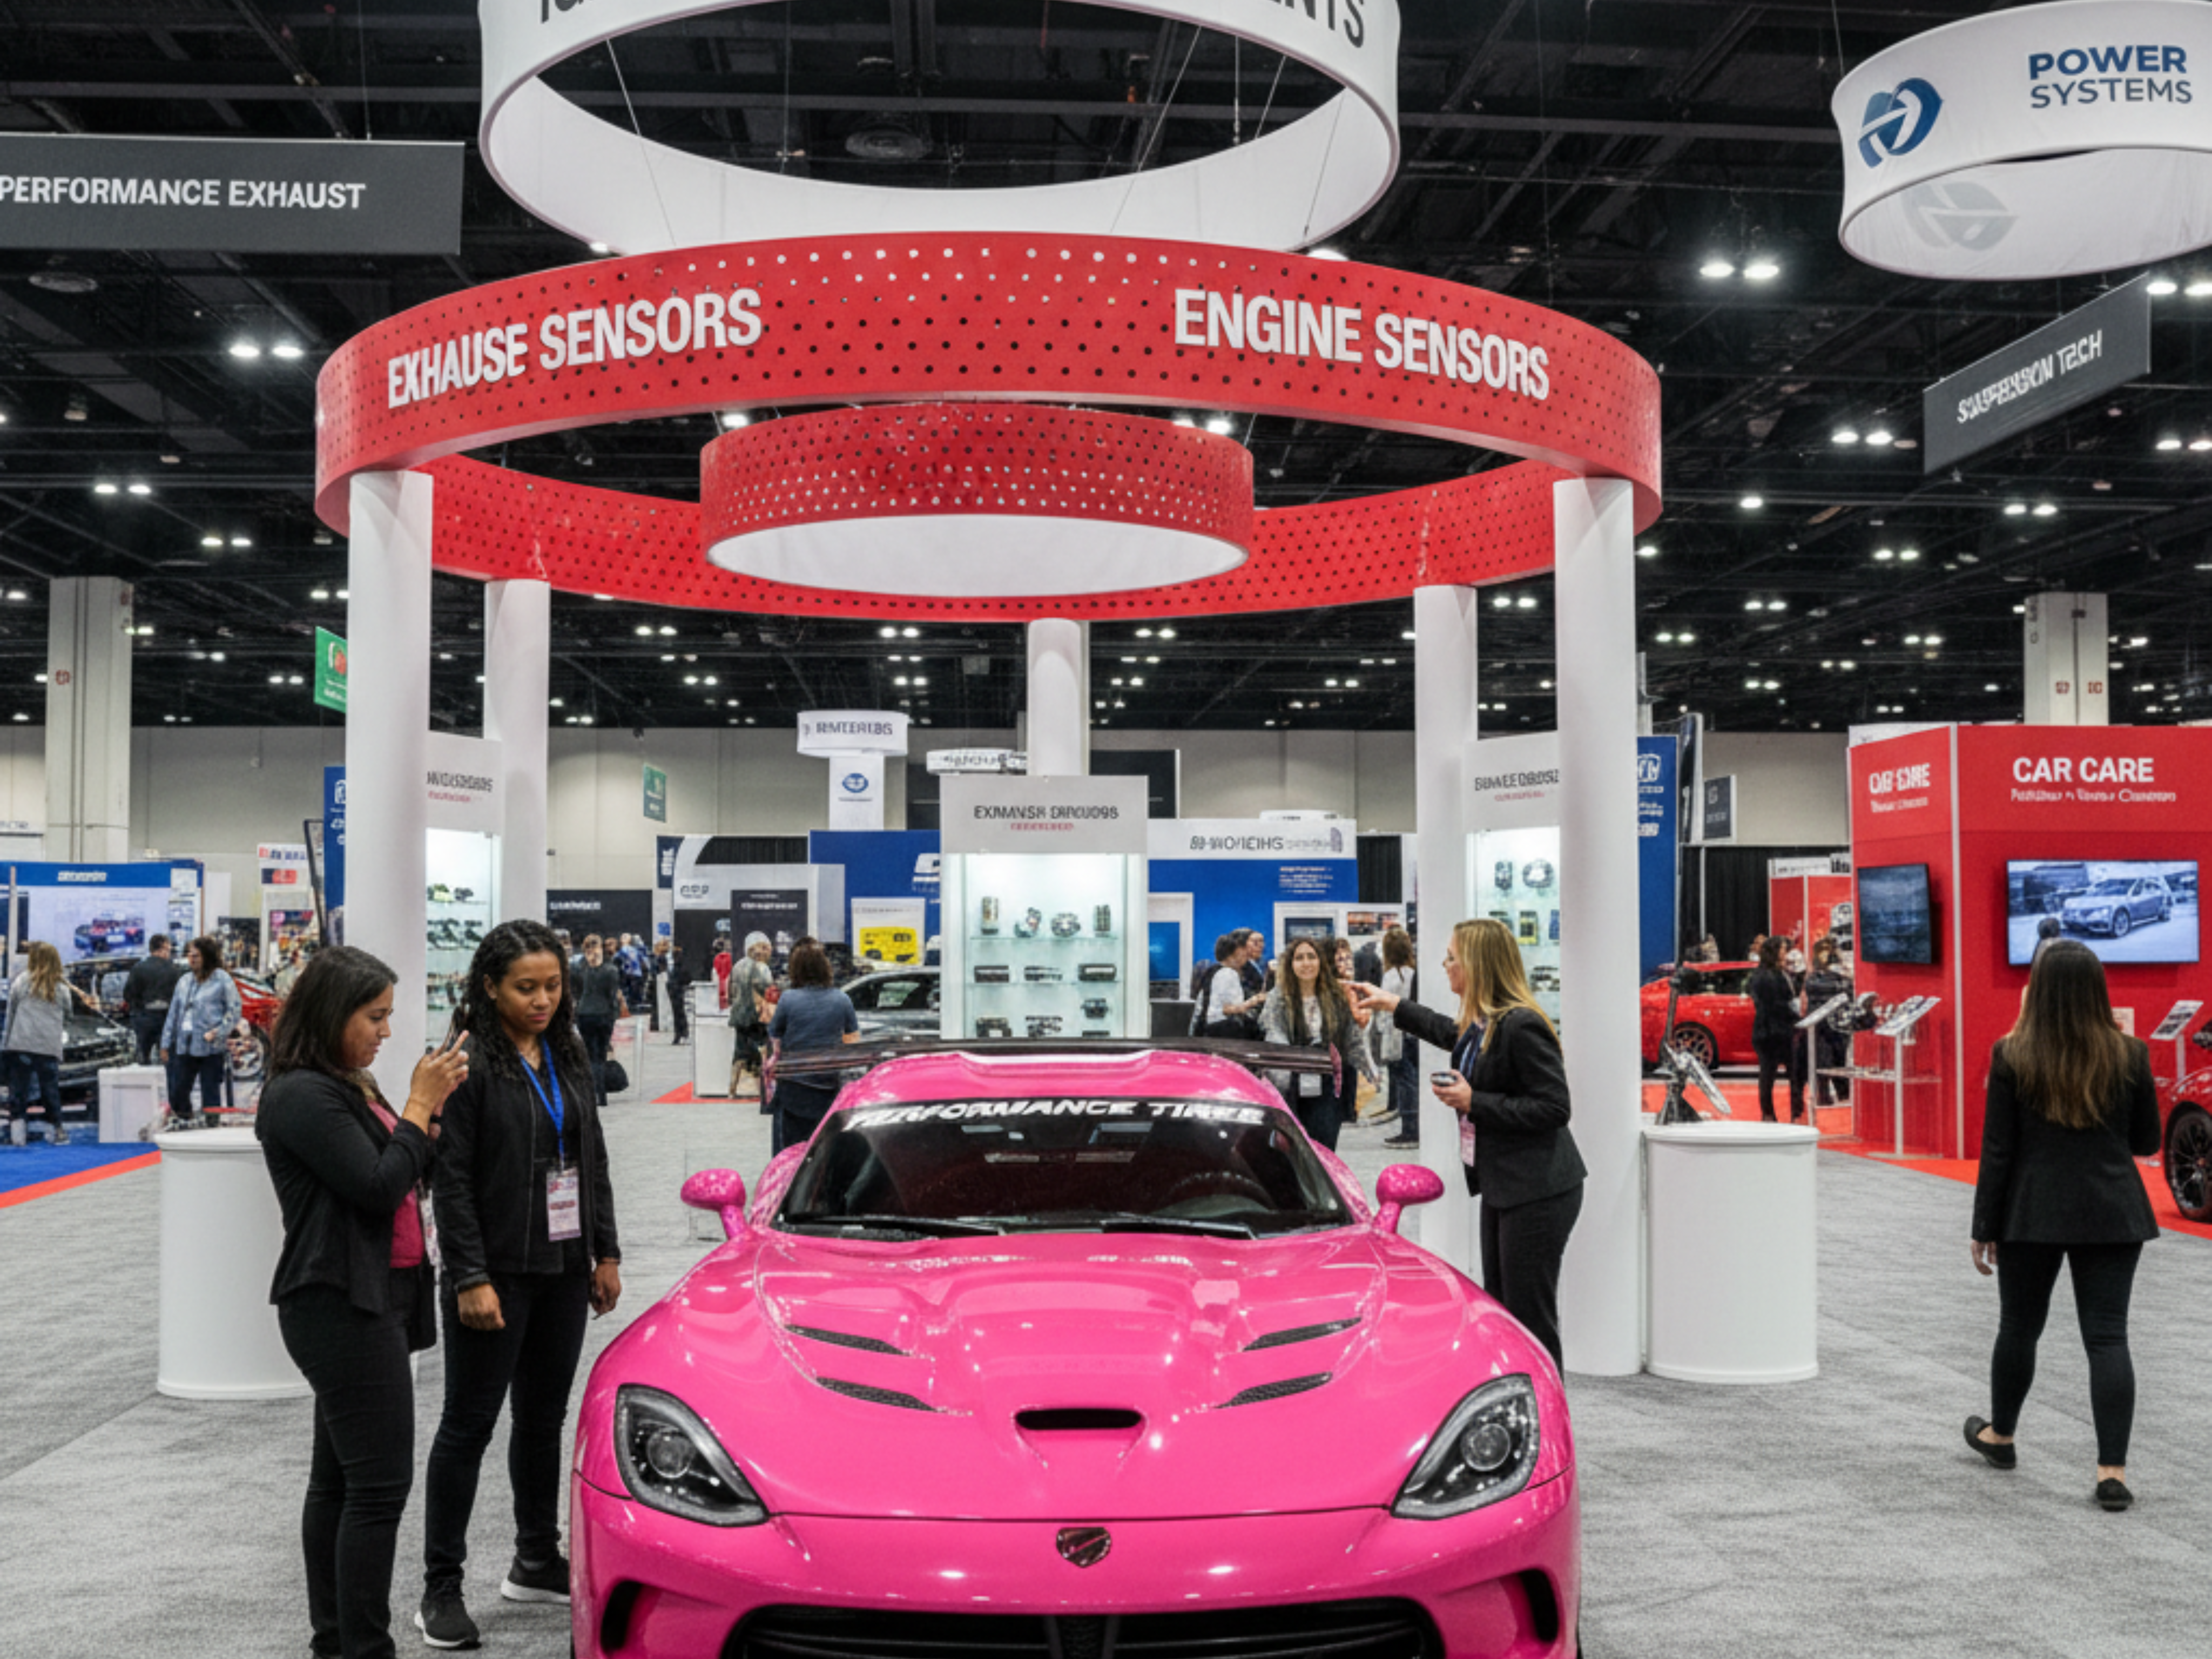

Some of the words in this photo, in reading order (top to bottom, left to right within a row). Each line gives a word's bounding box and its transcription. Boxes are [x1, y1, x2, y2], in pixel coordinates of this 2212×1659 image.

[2028, 45, 2187, 80] POWER
[2030, 78, 2193, 109] SYSTEMS
[0, 176, 220, 206] PERFORMANCE
[228, 180, 366, 210] EXHAUST
[388, 322, 528, 409] EXHAUSE
[539, 288, 763, 370] SENSORS
[1174, 288, 1363, 363] ENGINE
[1374, 313, 1550, 400] SENSORS
[2013, 757, 2073, 783] CAR
[2080, 757, 2155, 783] CARE
